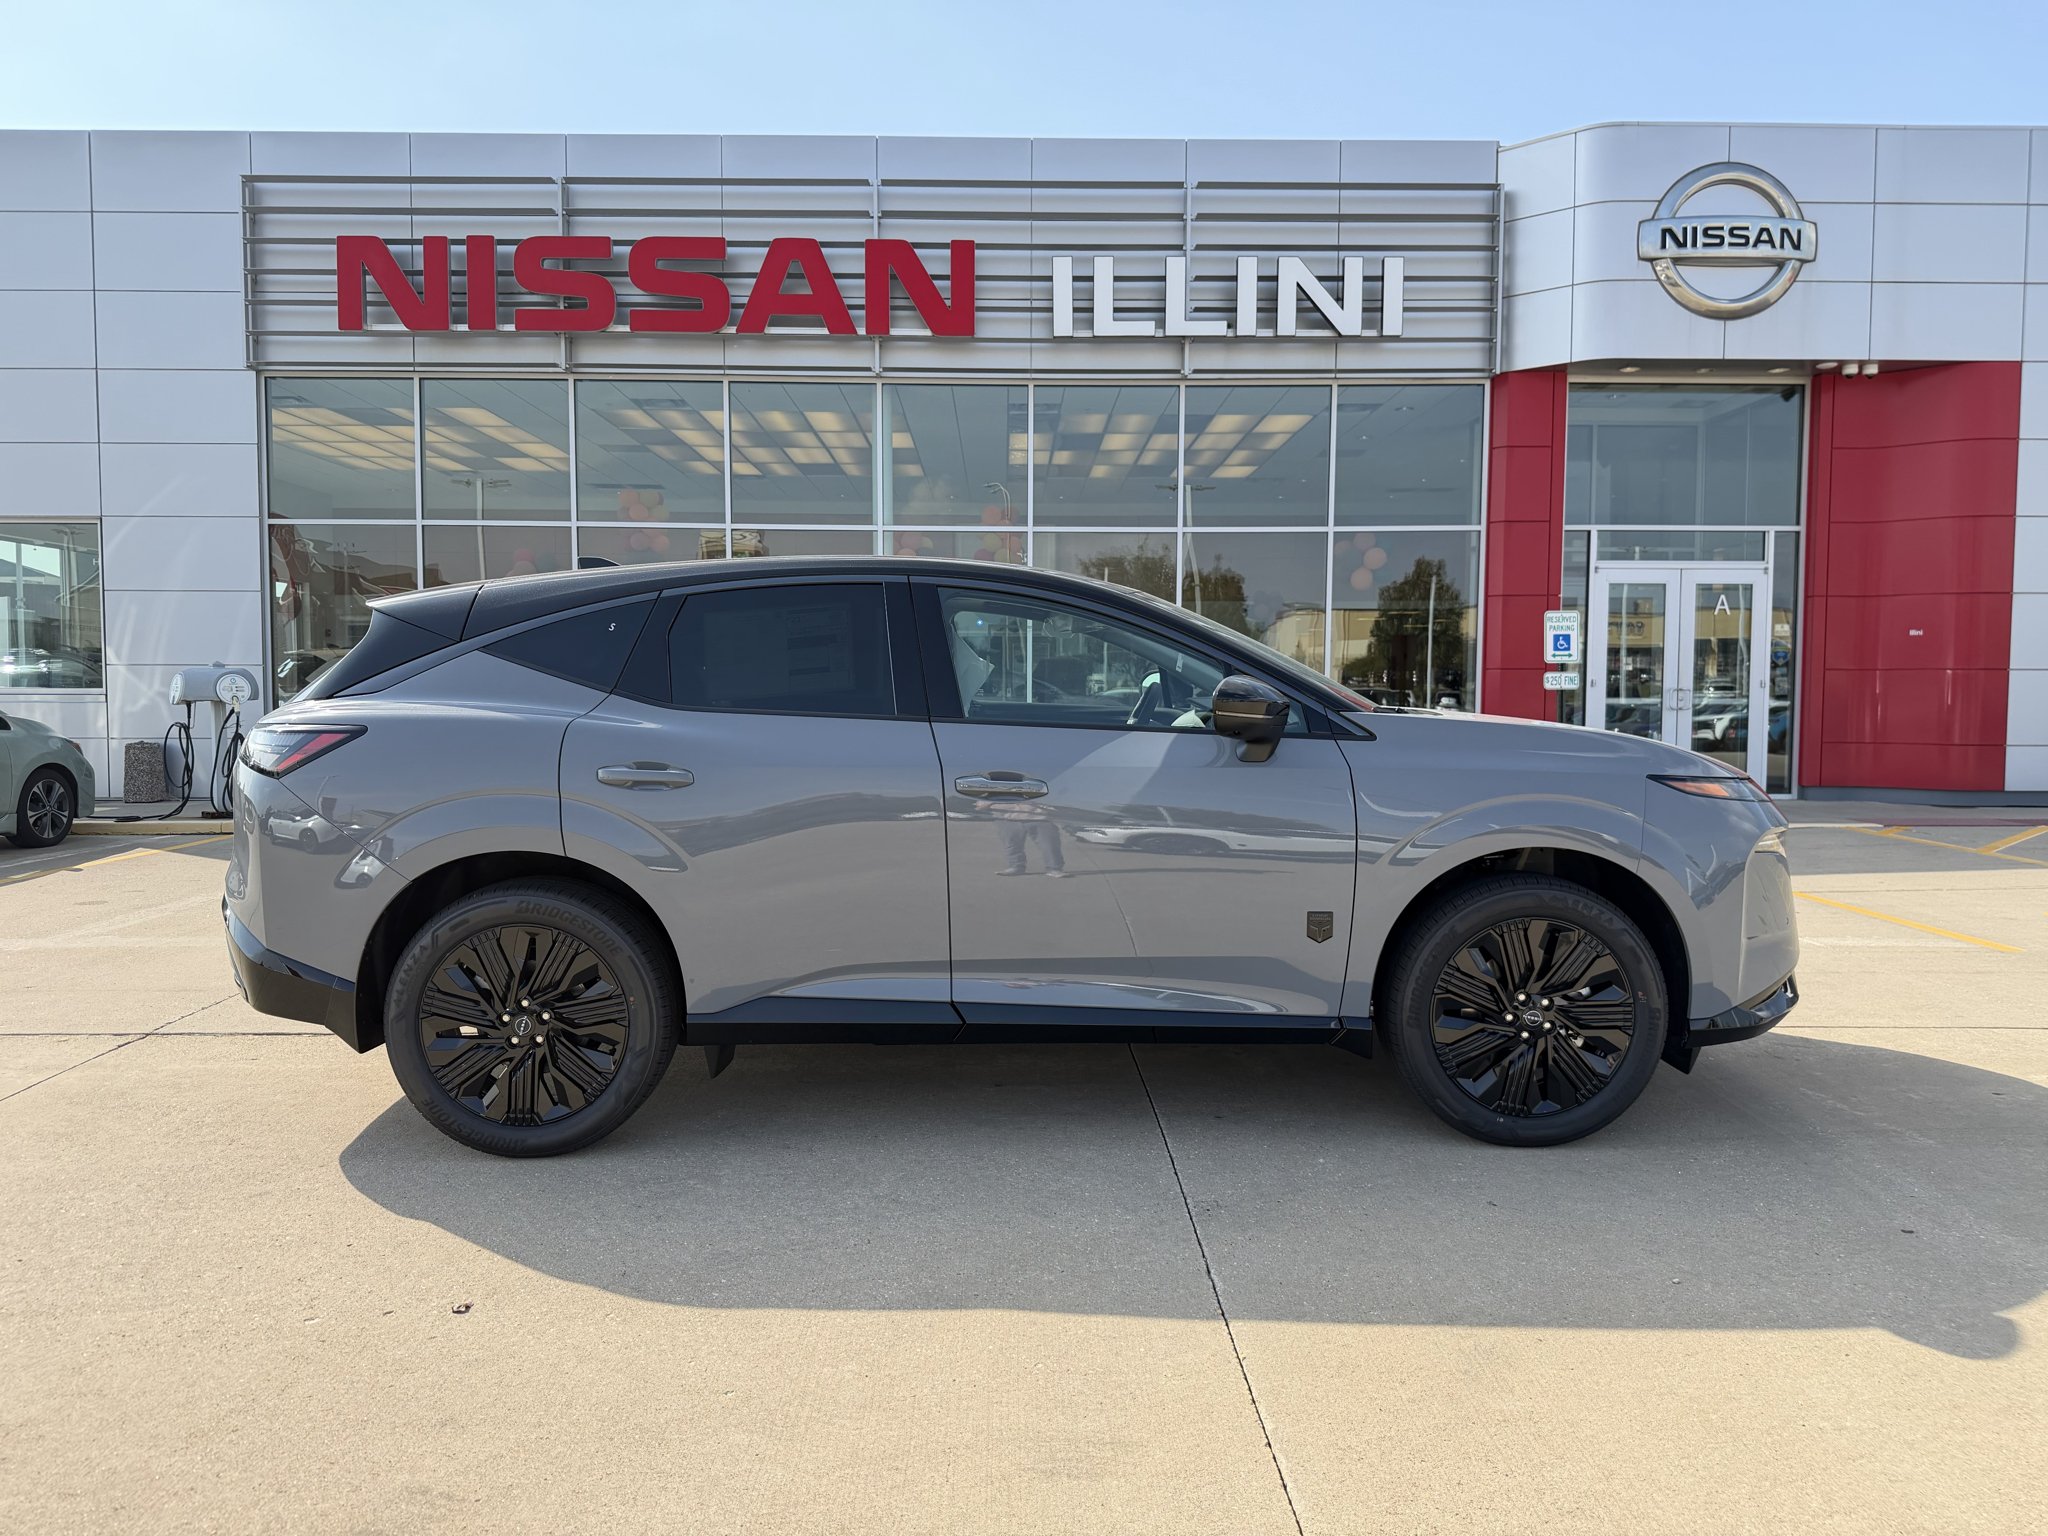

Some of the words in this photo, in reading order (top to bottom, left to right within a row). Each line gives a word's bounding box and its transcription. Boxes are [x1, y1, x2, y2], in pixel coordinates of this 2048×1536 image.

[1660, 225, 1802, 250] NISSAN
[336, 235, 975, 337] NISSAN
[1052, 256, 1405, 337] ILLINI
[1714, 594, 1731, 616] A
[1546, 615, 1577, 623] RESERVED
[1549, 624, 1575, 632] PARKING
[1564, 675, 1578, 686] FINE
[515, 900, 625, 957] BRIDGESTONE
[394, 942, 429, 1009] ALENZA
